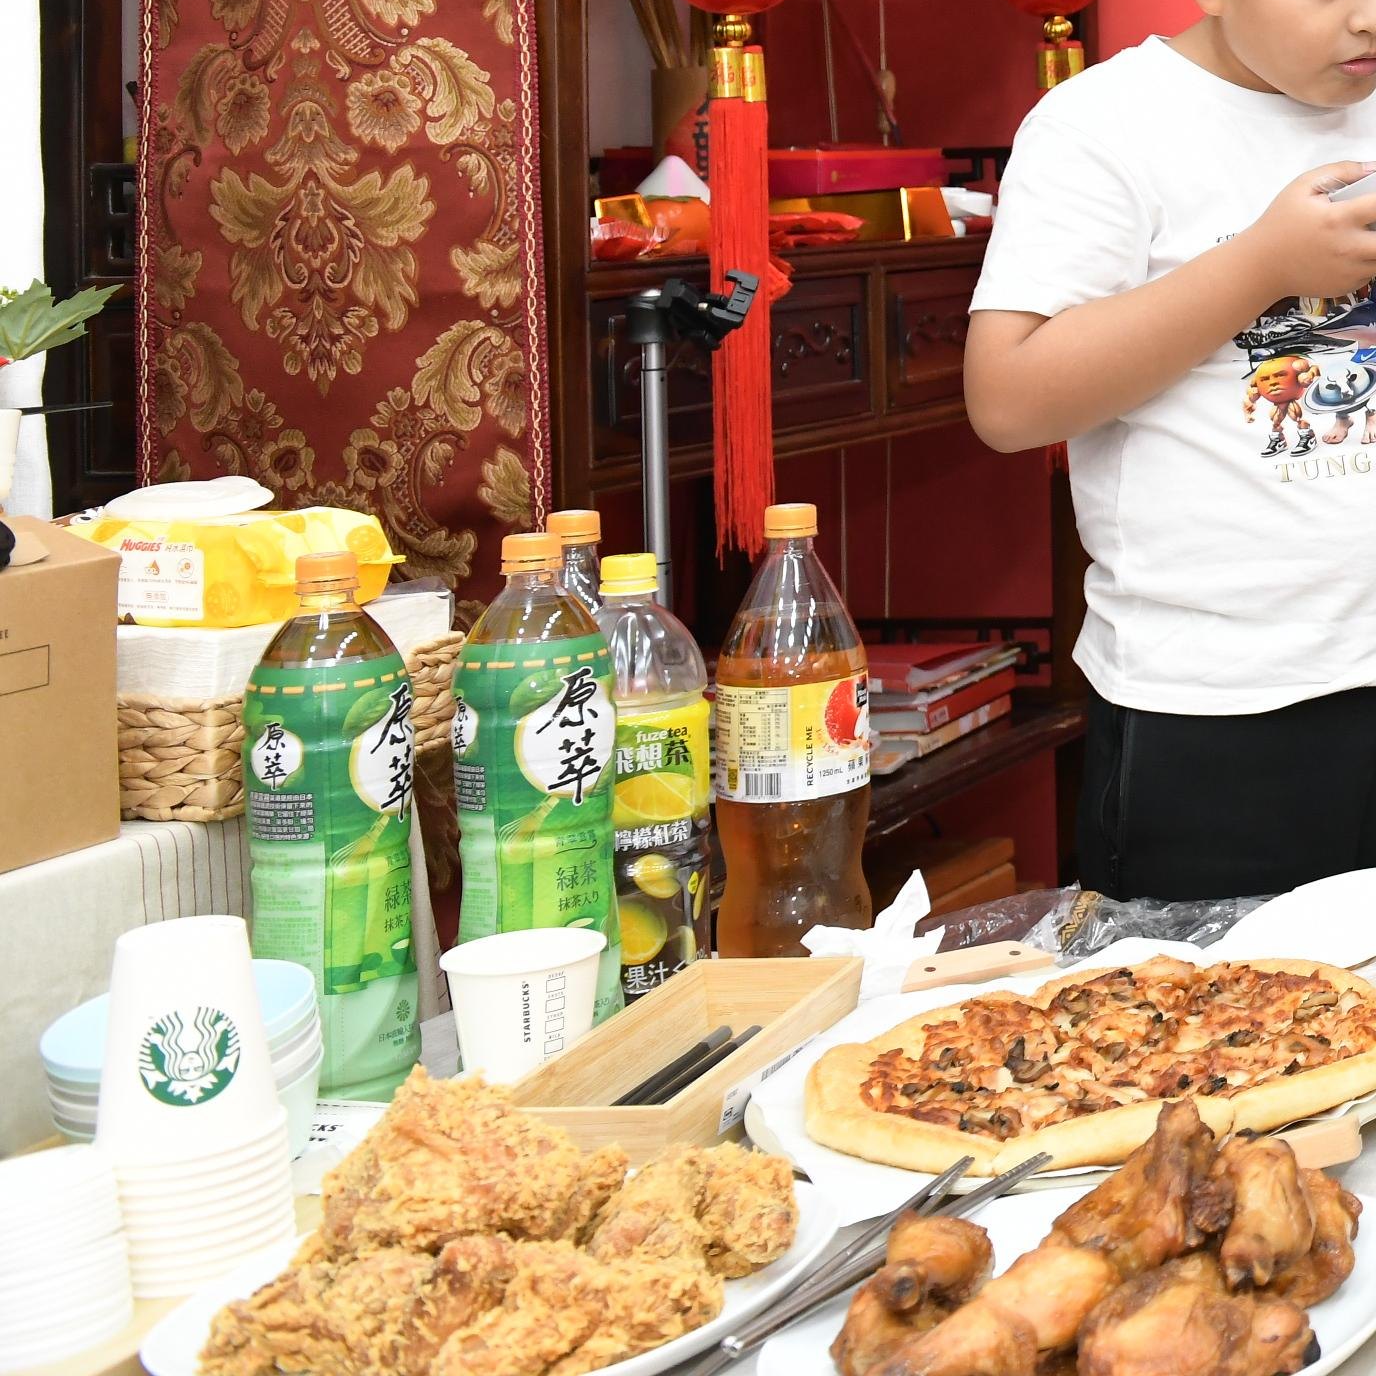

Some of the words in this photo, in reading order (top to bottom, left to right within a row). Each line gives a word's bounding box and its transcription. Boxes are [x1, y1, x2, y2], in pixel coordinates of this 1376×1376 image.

[1274, 451, 1372, 484] TUNG
[120, 539, 162, 552] HUGGIES
[536, 668, 602, 805] 原萃
[636, 726, 688, 744] fuzetea
[806, 725, 813, 741] ME
[257, 722, 288, 790] 原萃
[806, 743, 814, 787] RECYCLE
[521, 983, 532, 1043] STARBUCKS
